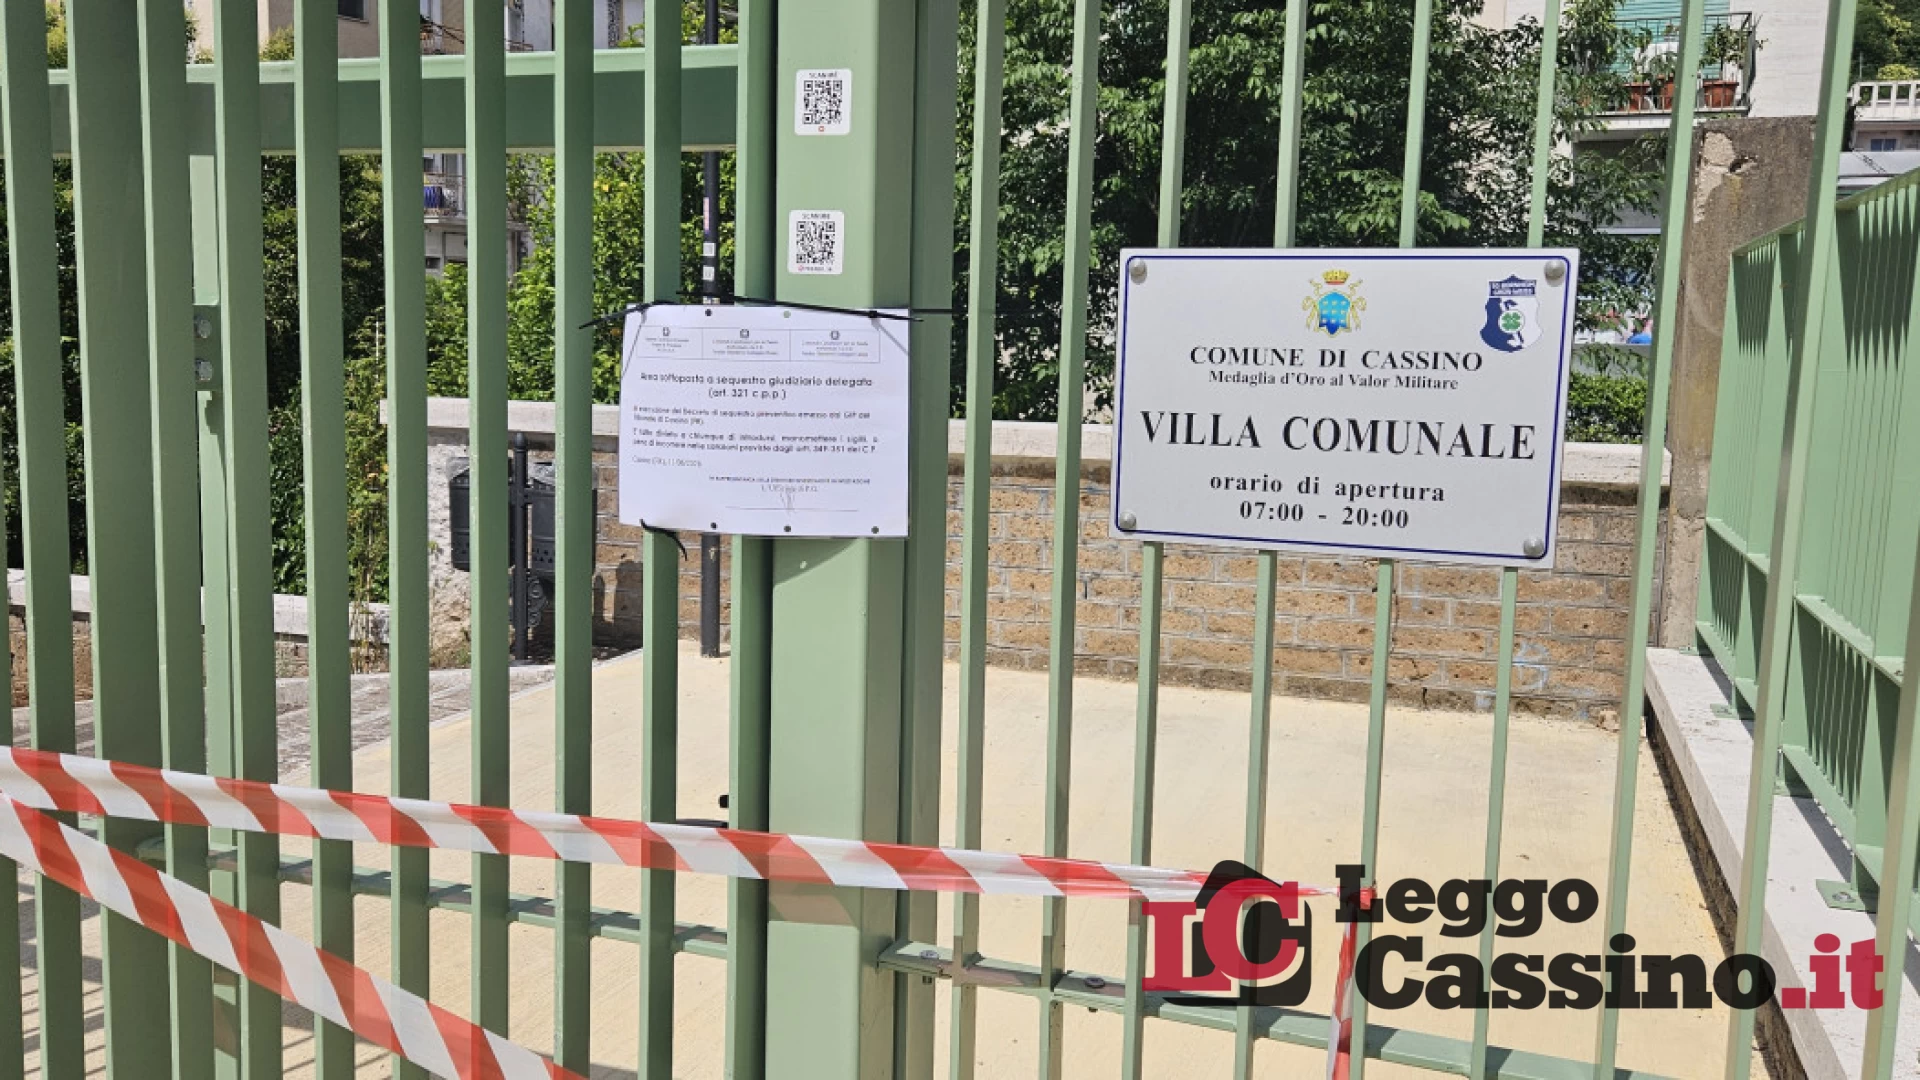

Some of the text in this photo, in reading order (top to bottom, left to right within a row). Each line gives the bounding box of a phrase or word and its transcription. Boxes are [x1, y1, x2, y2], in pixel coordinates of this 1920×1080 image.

[1190, 346, 1483, 372] COMUNE DI CASSINO
[660, 374, 704, 385] sottoposta
[717, 375, 766, 387] sequestro
[768, 376, 822, 387] giudiziario
[825, 377, 873, 388] delegato
[731, 388, 748, 398] 321
[1209, 370, 1459, 390] Medaglia d'Oro al Valor Militare
[1140, 410, 1536, 460] VILLA COMUNALE
[1209, 473, 1445, 502] orario di apertura
[1239, 501, 1304, 522] 07:00
[1342, 505, 1410, 529] 20:00
